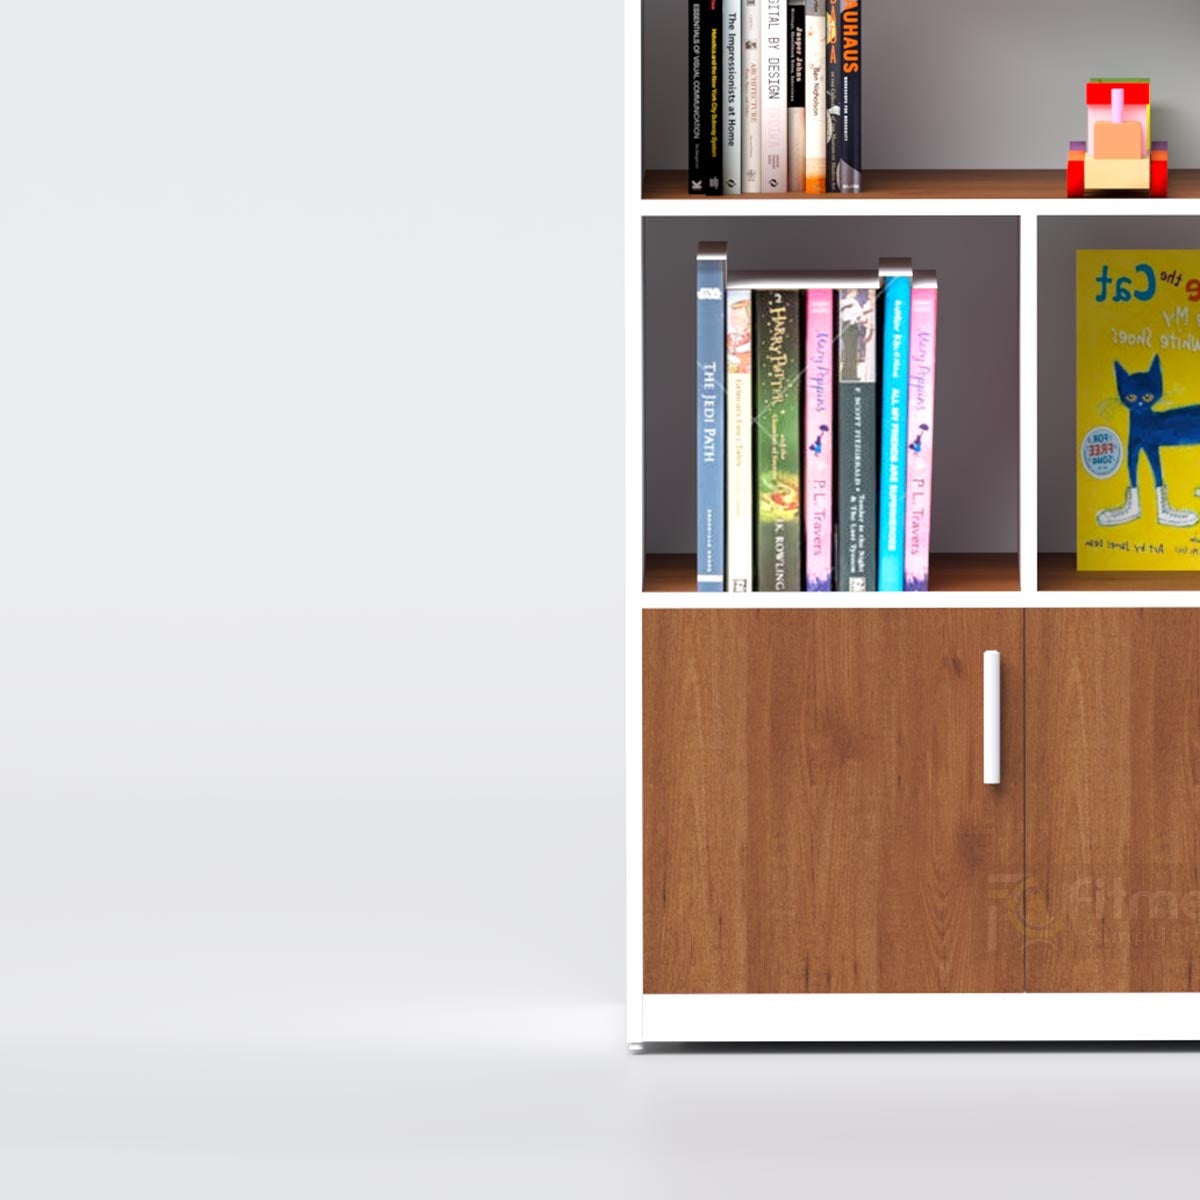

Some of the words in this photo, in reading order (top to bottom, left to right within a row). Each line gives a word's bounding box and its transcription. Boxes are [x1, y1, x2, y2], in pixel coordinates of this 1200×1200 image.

[728, 13, 736, 30] The
[692, 46, 700, 54] OF
[768, 38, 780, 50] BY
[728, 34, 736, 104] Impressionists
[768, 58, 780, 100] DESIGN
[728, 106, 736, 116] at
[728, 120, 736, 146] Home
[703, 362, 716, 390] THE
[703, 394, 716, 422] JEDI
[703, 428, 716, 462] PATH
[814, 510, 826, 556] Travers
[910, 508, 924, 554] Travers
[774, 536, 785, 590] ROWLING
